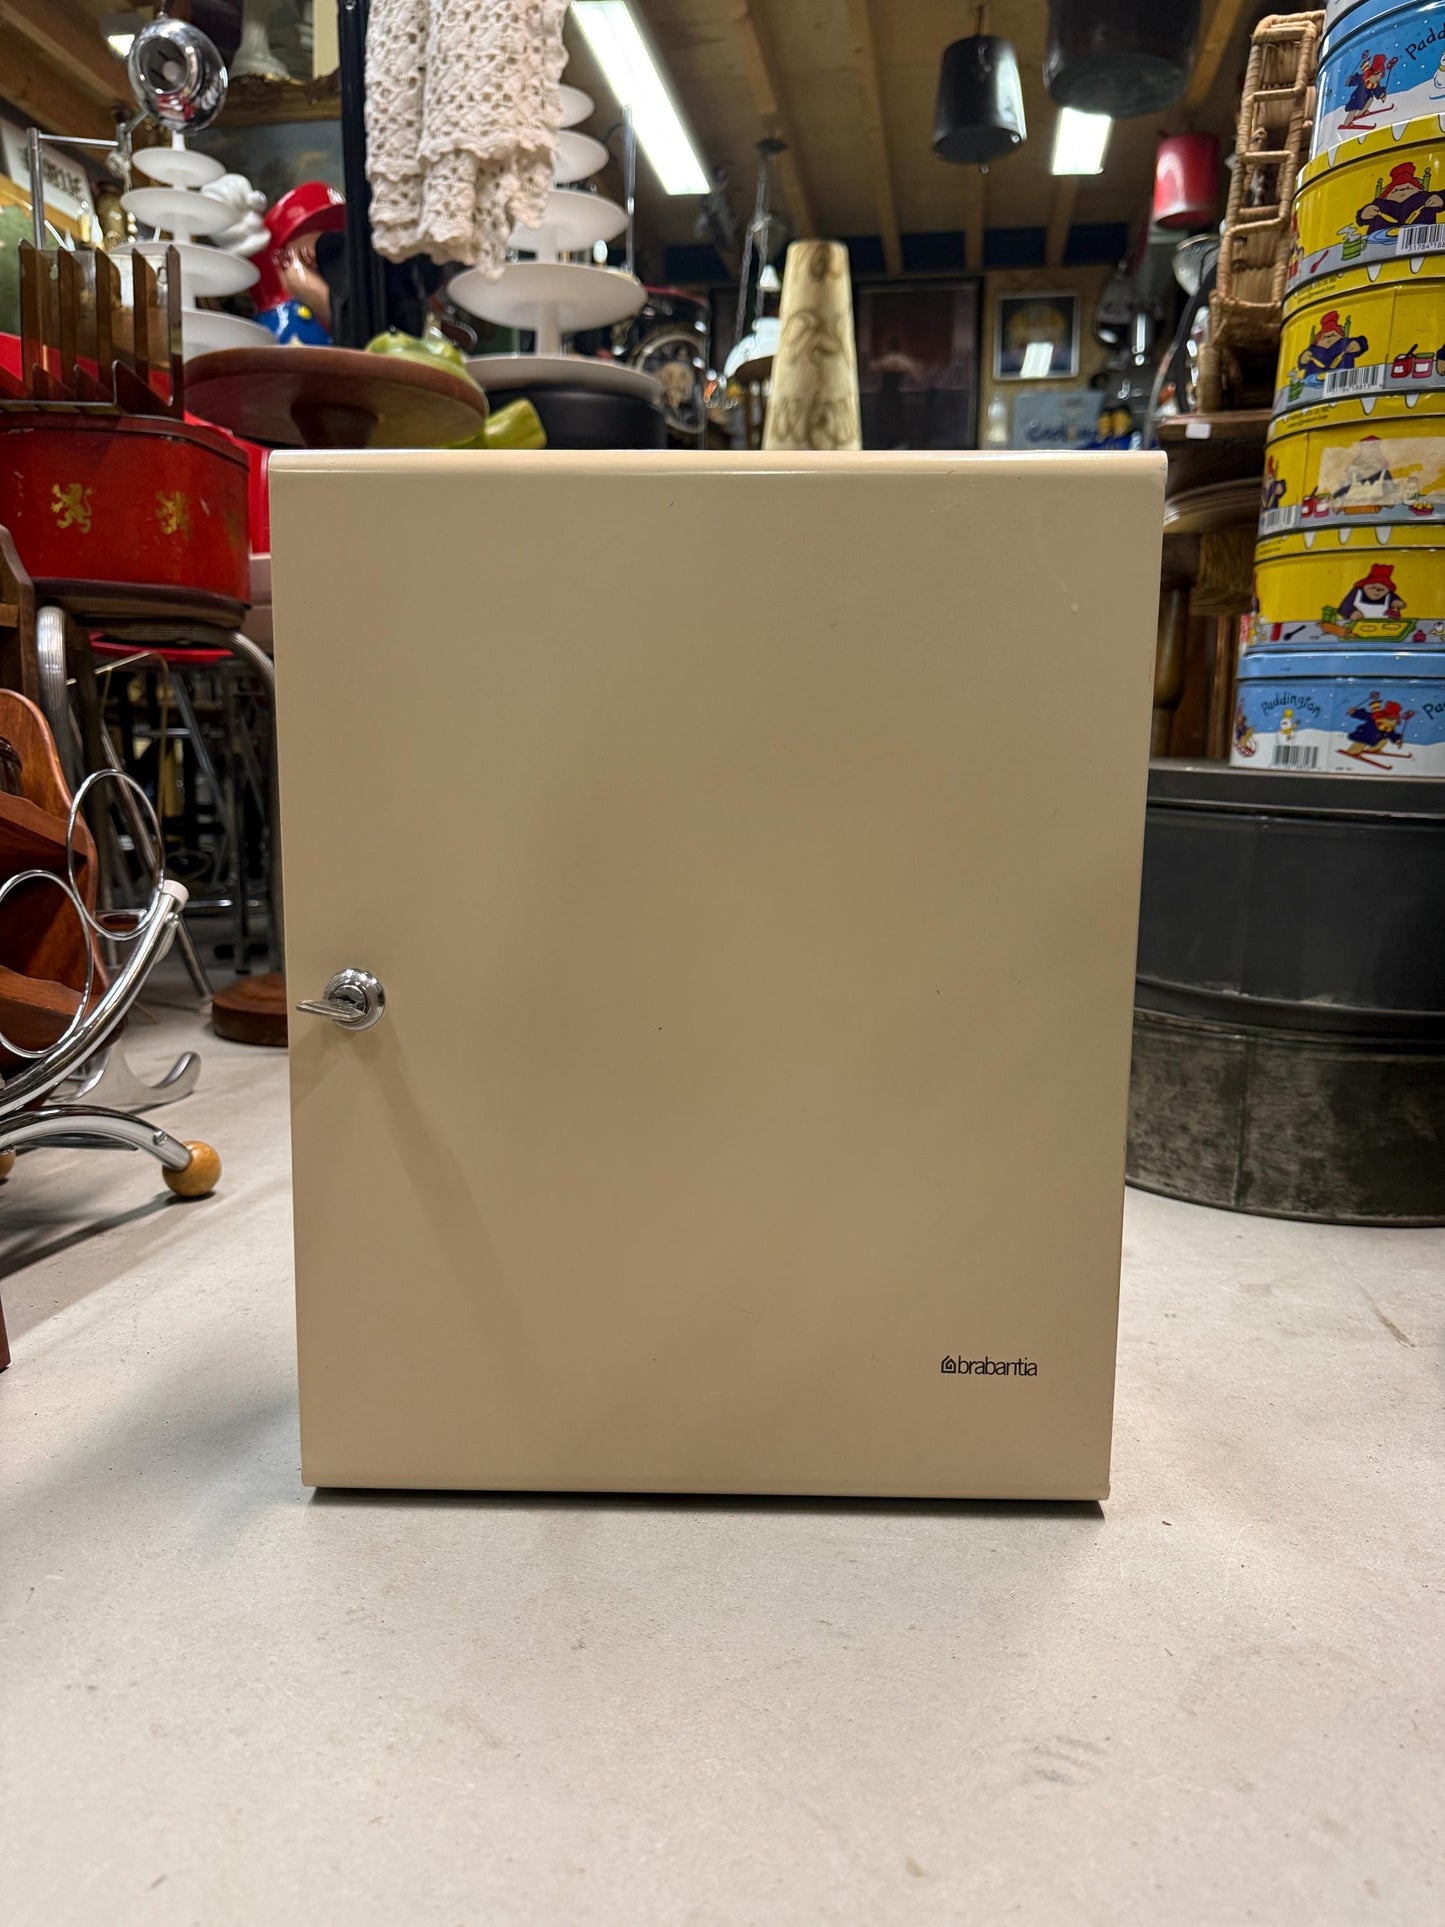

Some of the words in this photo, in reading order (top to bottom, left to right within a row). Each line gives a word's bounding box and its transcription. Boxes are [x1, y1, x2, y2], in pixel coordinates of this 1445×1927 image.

[1261, 692, 1322, 719] Paddington
[1422, 702, 1445, 720] Pa
[957, 1355, 1038, 1377] brabantia
